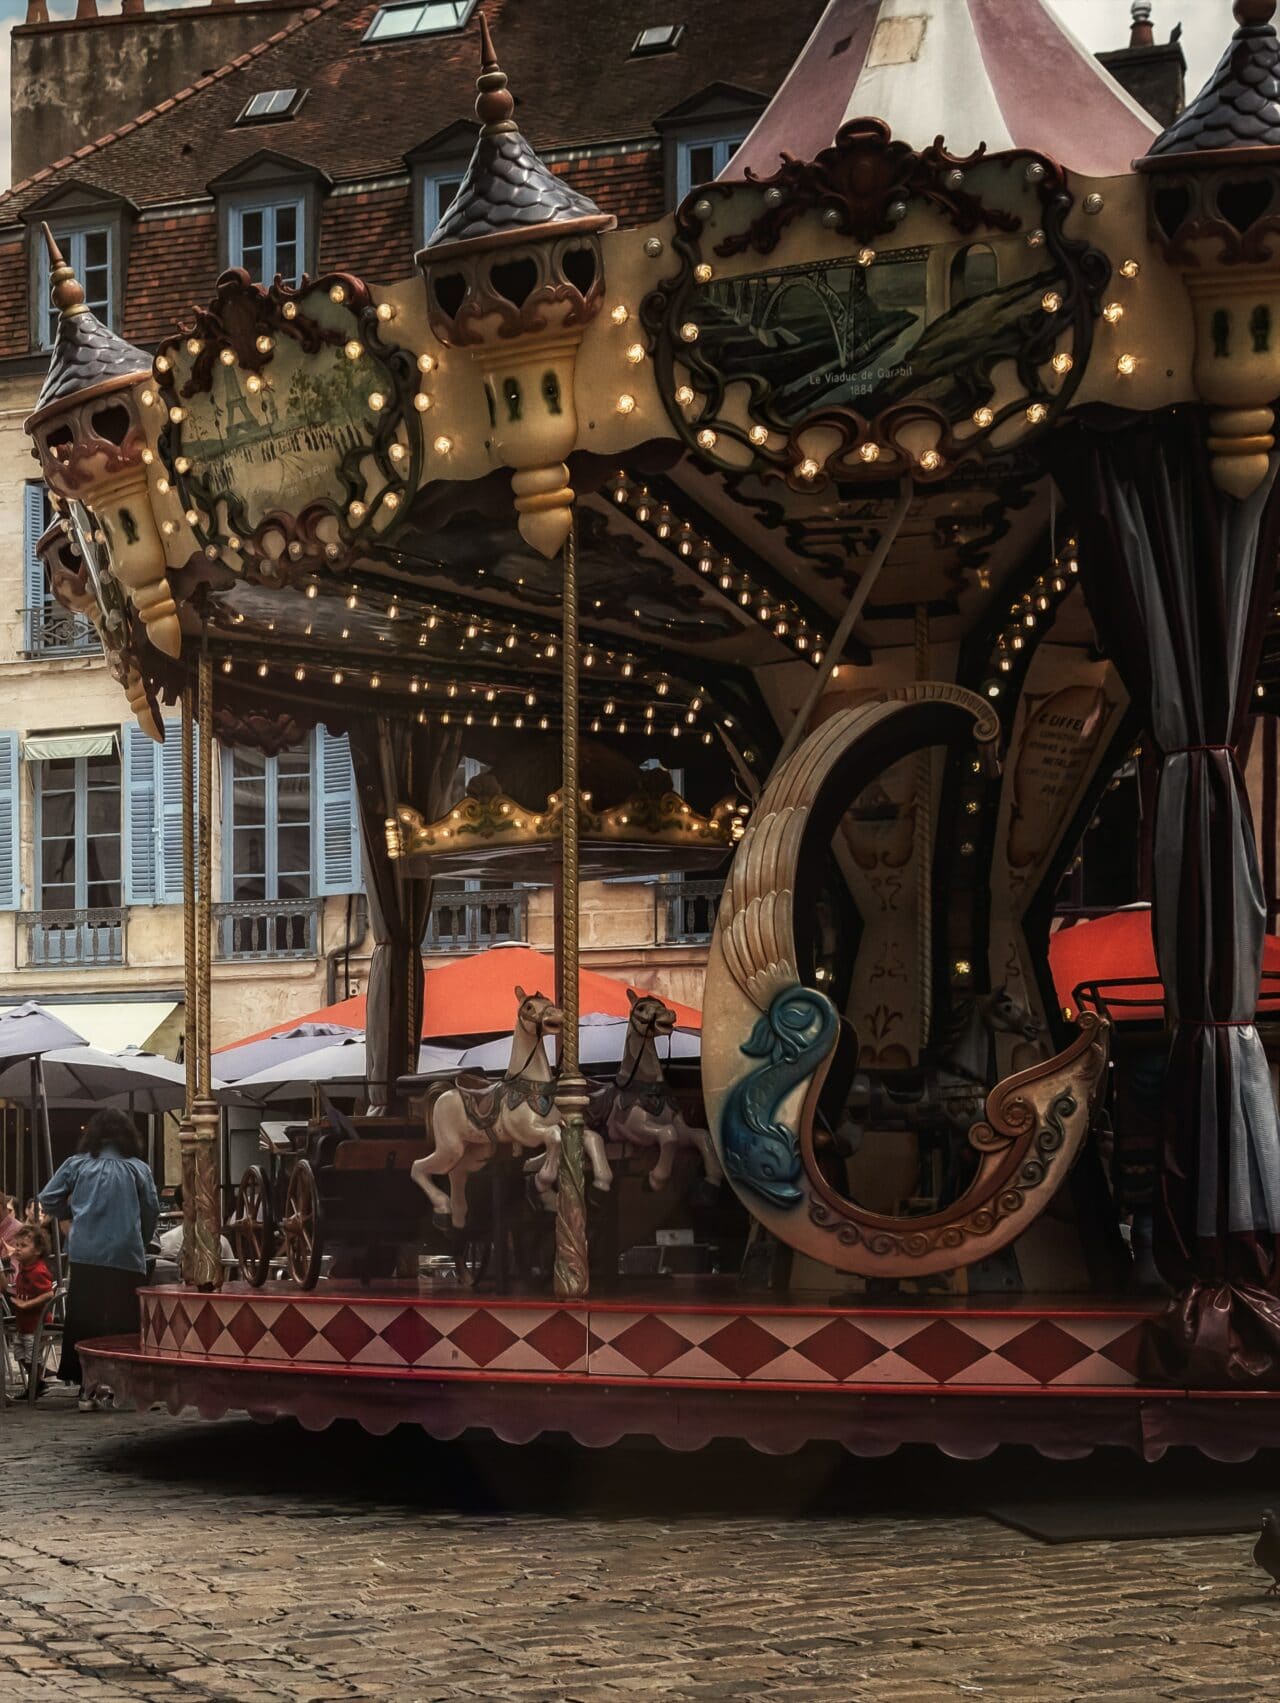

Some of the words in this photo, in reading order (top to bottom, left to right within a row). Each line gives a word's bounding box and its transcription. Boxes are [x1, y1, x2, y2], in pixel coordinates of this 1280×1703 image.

[809, 375, 820, 385] Le
[825, 371, 857, 383] Viaduc
[861, 370, 873, 380] de
[850, 383, 873, 395] 1884
